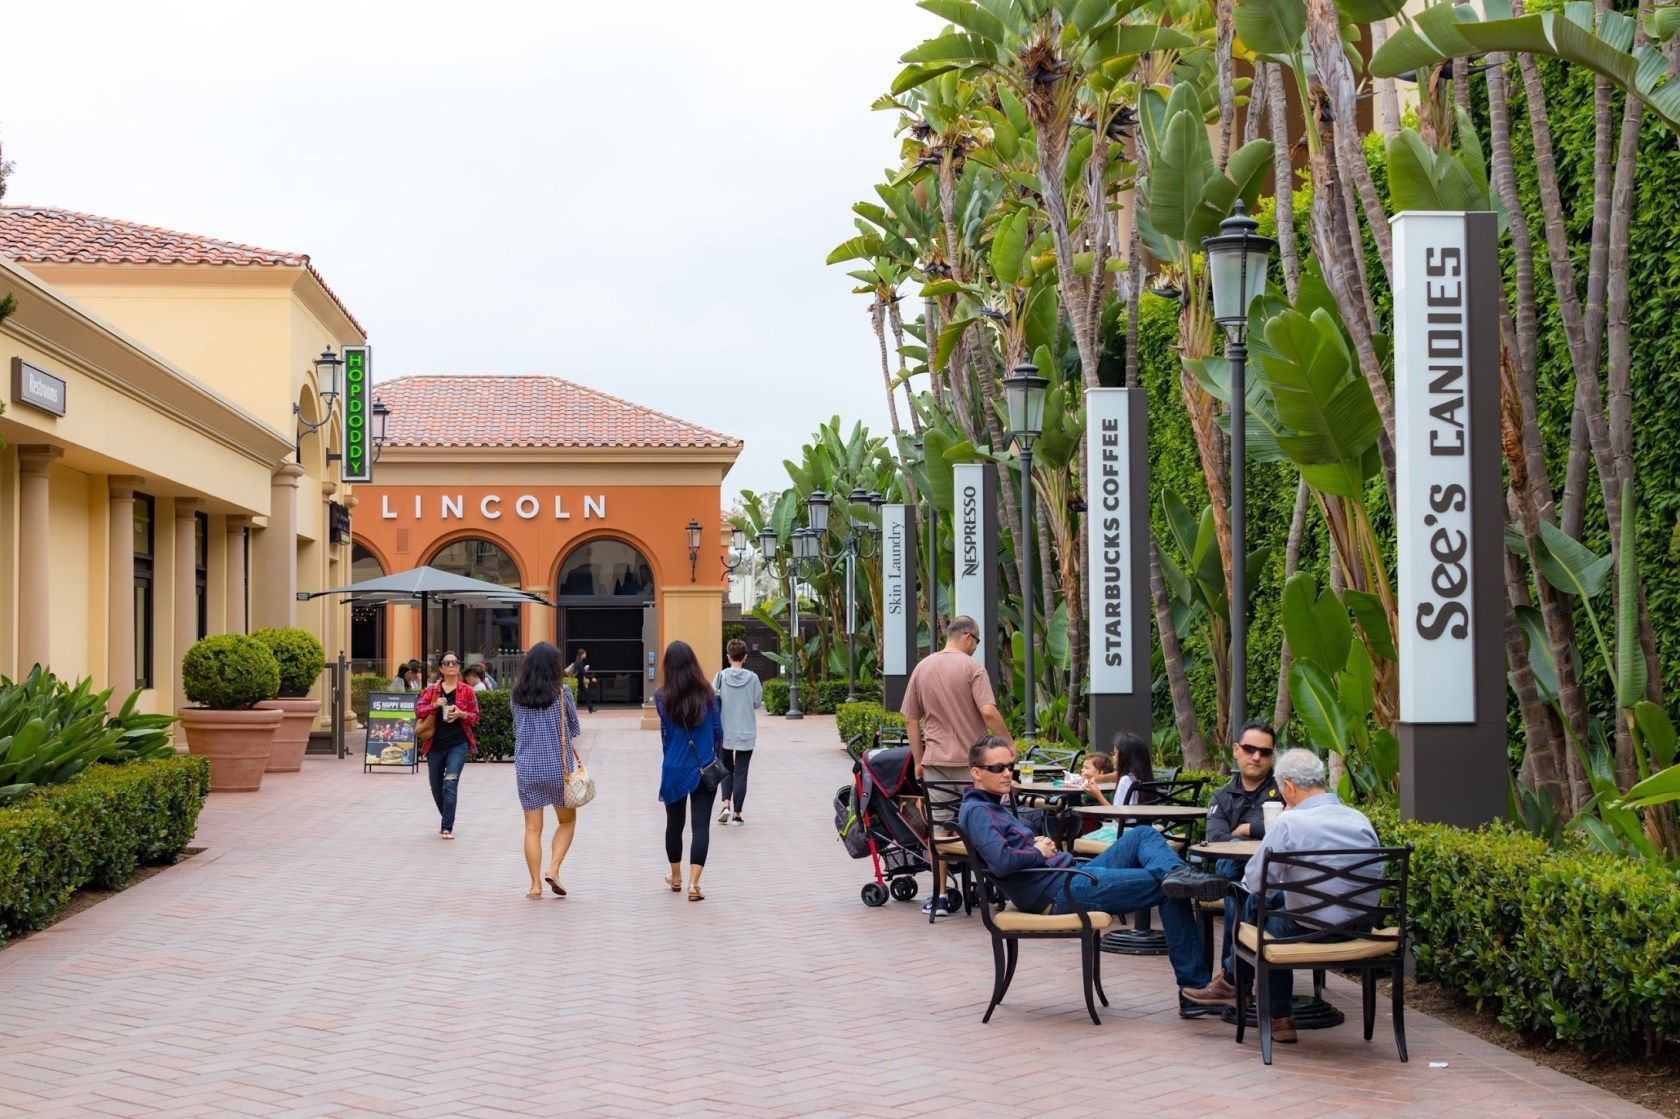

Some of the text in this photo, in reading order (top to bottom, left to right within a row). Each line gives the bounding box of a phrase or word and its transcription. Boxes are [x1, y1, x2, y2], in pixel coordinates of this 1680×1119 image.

[29, 372, 57, 402] Restrooms
[348, 354, 363, 474] HOPDODDY
[1416, 247, 1470, 641] See's CANDIES
[382, 494, 606, 519] LINCOLN
[962, 485, 979, 579] NESPRESSO
[1102, 418, 1122, 667] STARBUCKS COFFEE
[888, 521, 905, 615] Skin Laundry
[373, 701, 381, 710] $5
